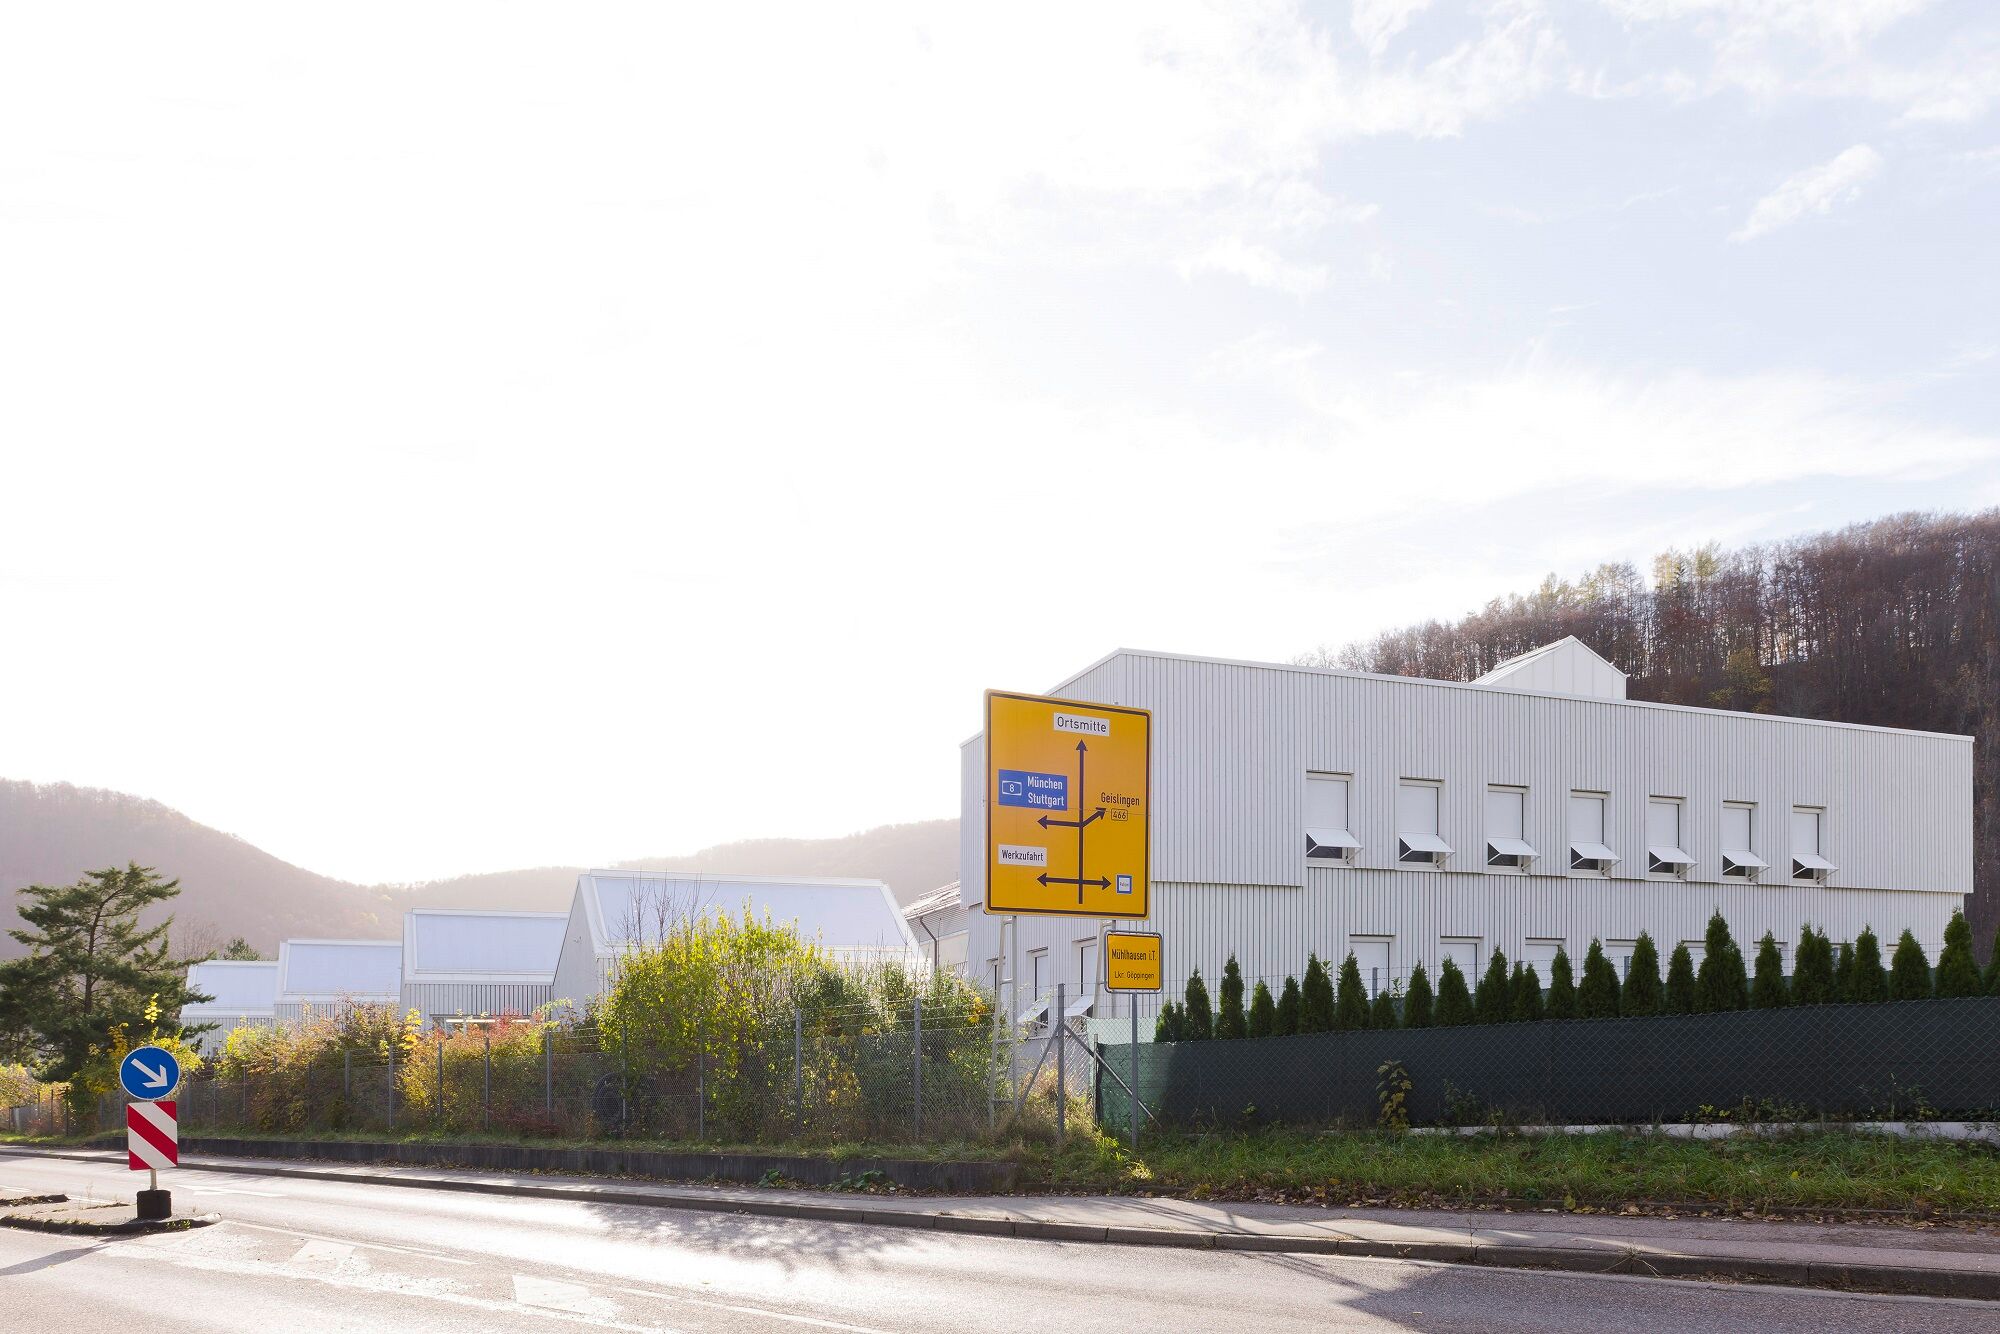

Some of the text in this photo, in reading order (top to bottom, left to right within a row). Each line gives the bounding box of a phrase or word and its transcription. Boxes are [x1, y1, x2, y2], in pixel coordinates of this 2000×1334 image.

[1057, 716, 1107, 733] Ortsmitte
[1009, 784, 1015, 793] 8
[1027, 776, 1063, 790] München
[1028, 793, 1065, 808] Stuttgart
[1101, 792, 1140, 808] Geislingen
[1113, 811, 1127, 820] 466
[1002, 849, 1044, 862] Werkzufahrt
[1111, 948, 1147, 960] Mühlhausen
